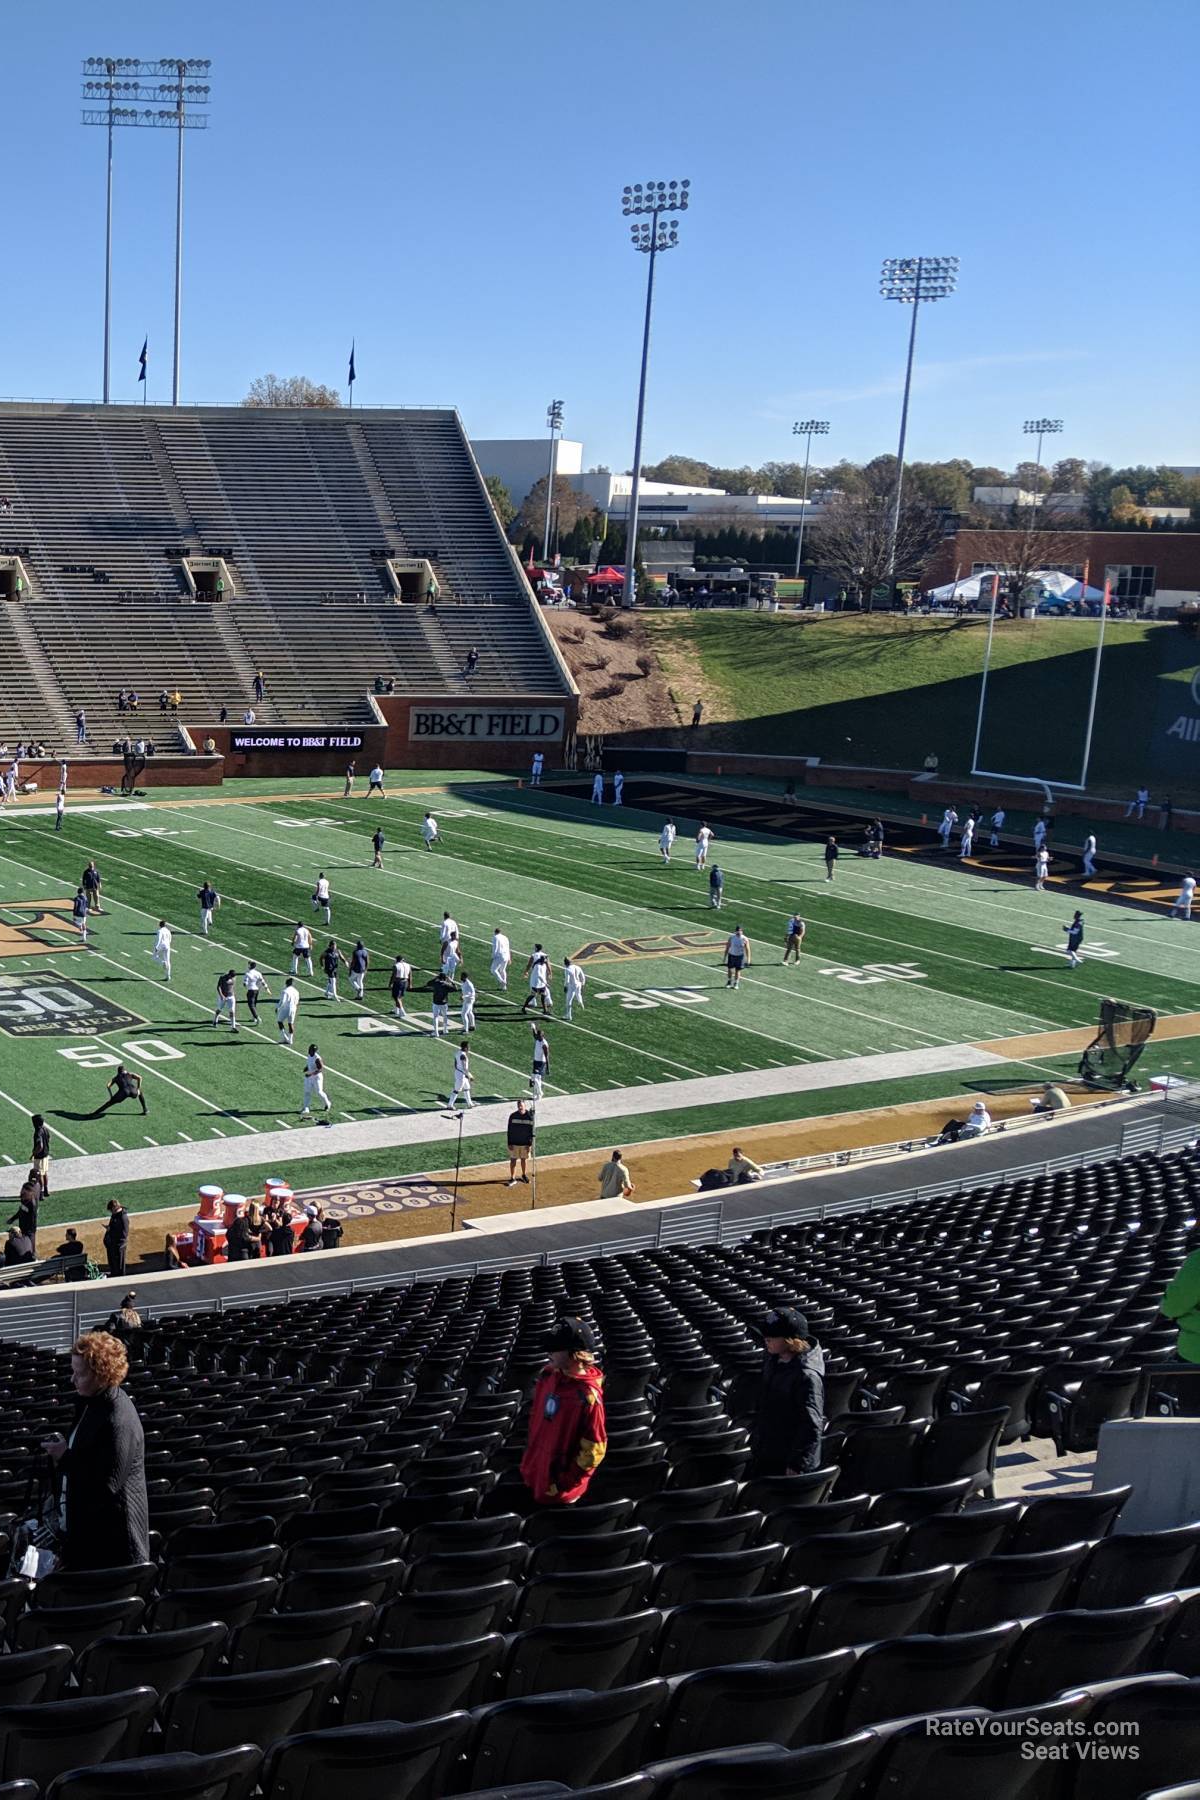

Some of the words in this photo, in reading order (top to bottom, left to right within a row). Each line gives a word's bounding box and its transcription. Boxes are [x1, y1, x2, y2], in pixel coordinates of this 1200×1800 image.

[414, 713, 483, 736] BB&T
[485, 713, 560, 736] FIELD
[234, 737, 285, 747] WELCOME
[287, 737, 300, 747] TO
[302, 736, 327, 747] BB&T
[329, 736, 362, 747] FIELD
[106, 827, 178, 838] 30
[568, 932, 730, 965] ACC
[818, 961, 929, 985] 20
[594, 985, 712, 1011] 30
[11, 1009, 108, 1024] YEARS
[68, 1015, 134, 1029] FIELD
[356, 1011, 466, 1035] 40
[56, 1039, 187, 1069] 50
[357, 1206, 367, 1214] 7
[433, 1194, 449, 1202] 10
